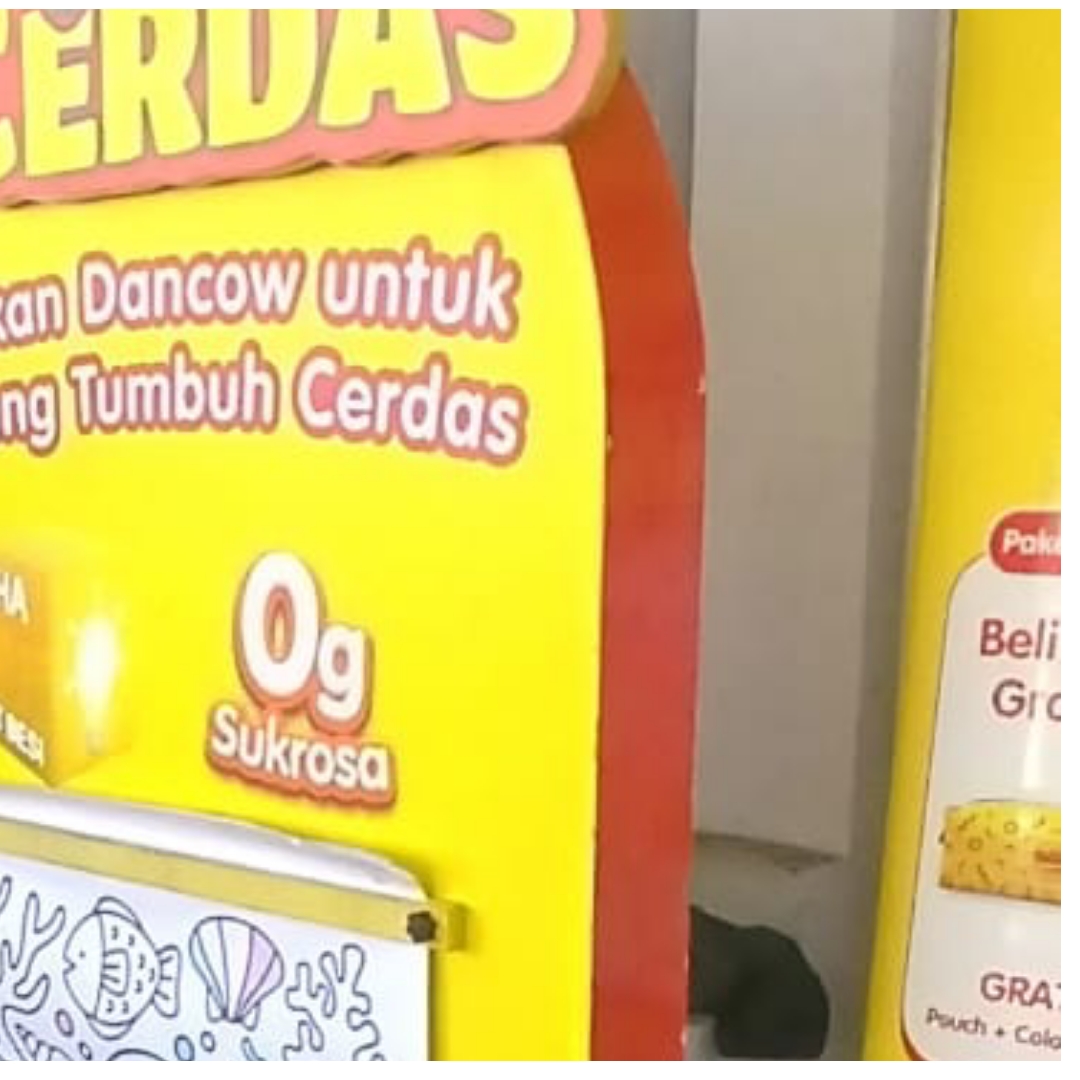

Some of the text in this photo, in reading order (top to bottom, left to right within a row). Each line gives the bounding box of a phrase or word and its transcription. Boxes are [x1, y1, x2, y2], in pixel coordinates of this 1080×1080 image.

[79, 255, 305, 330] Dancow
[320, 239, 520, 337] untuk
[68, 344, 278, 430] Tumbuh
[295, 350, 525, 461] Cerdas
[209, 702, 392, 793] Sukrosa
[925, 1007, 988, 1036] Pouch
[979, 971, 1061, 1011] GRA
